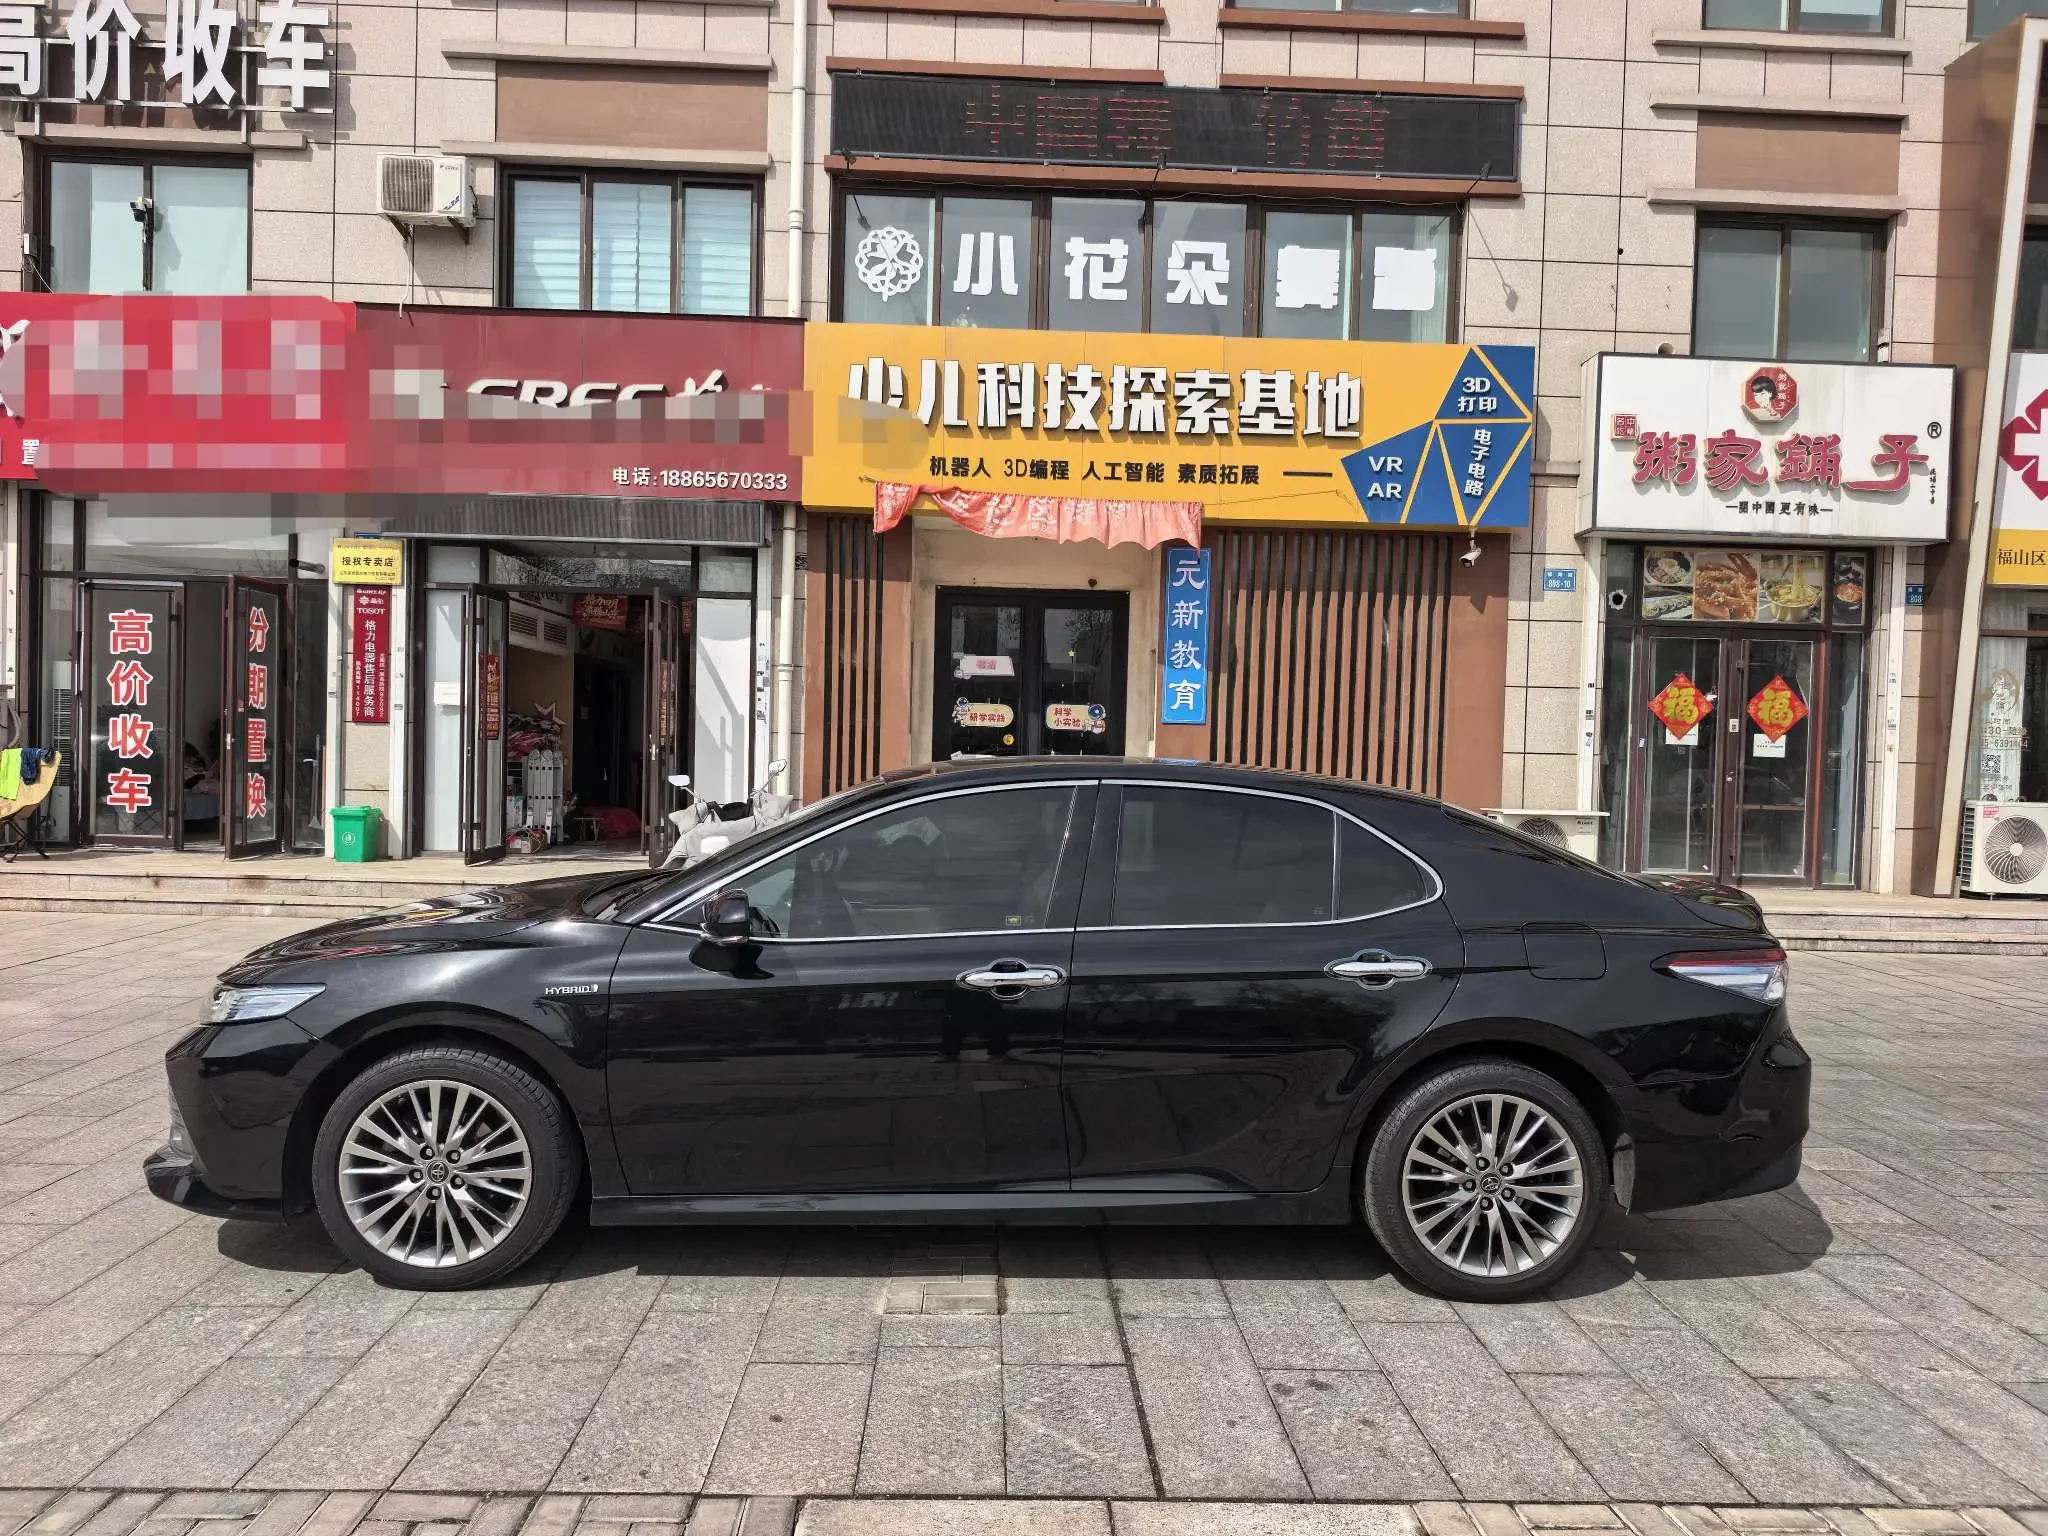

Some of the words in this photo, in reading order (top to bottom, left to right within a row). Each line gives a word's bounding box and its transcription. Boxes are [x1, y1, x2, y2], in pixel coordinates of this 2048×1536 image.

[1461, 376, 1491, 393] 3D
[1457, 396, 1498, 413] 打印
[929, 455, 991, 478] 机器人
[1003, 458, 1070, 481] 3D编程
[1082, 460, 1166, 484] 人工智能
[1177, 463, 1260, 486] 素质拓展
[1368, 456, 1404, 473] VR
[1463, 428, 1492, 497] 电子电路
[1367, 482, 1403, 499] AR
[342, 556, 394, 567] 授权专卖店
[1998, 548, 2048, 566] 福山区
[356, 607, 387, 615] TOSOT
[1168, 559, 1206, 711] 元新教育
[364, 619, 377, 718] 格力电器售后服务商
[106, 608, 154, 814] 高价收车
[246, 605, 270, 820] 分期置换
[1053, 707, 1073, 717] 科学
[1662, 685, 1700, 725] 福
[1757, 686, 1795, 728] 福
[544, 985, 591, 996] HYBRID
